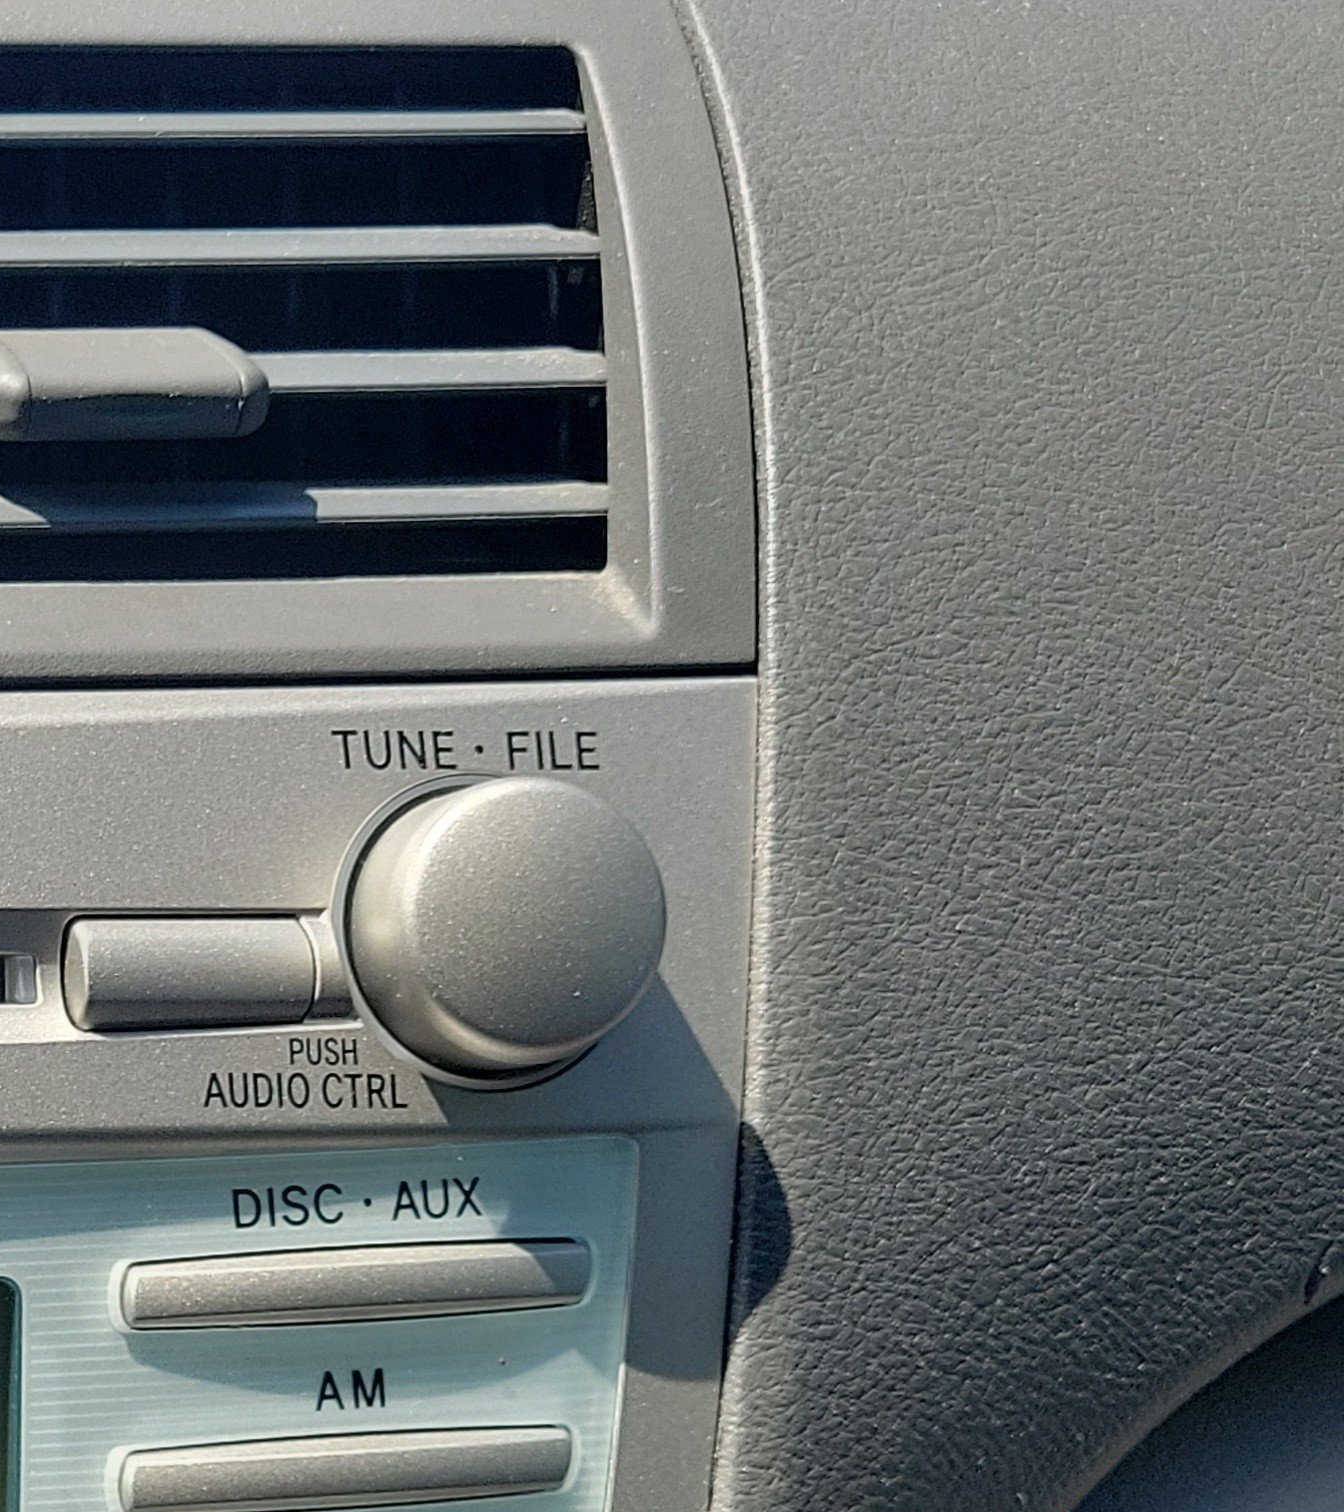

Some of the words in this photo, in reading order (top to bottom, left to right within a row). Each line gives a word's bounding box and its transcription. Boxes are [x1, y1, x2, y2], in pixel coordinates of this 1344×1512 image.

[331, 730, 459, 771] TUNE
[506, 730, 600, 771] FILE
[288, 1037, 359, 1067] PUSH
[204, 1074, 311, 1110] AUDIO
[321, 1073, 409, 1109] CTRL
[231, 1183, 344, 1229] DISC
[392, 1177, 484, 1221] AUX
[315, 1368, 387, 1412] AM
